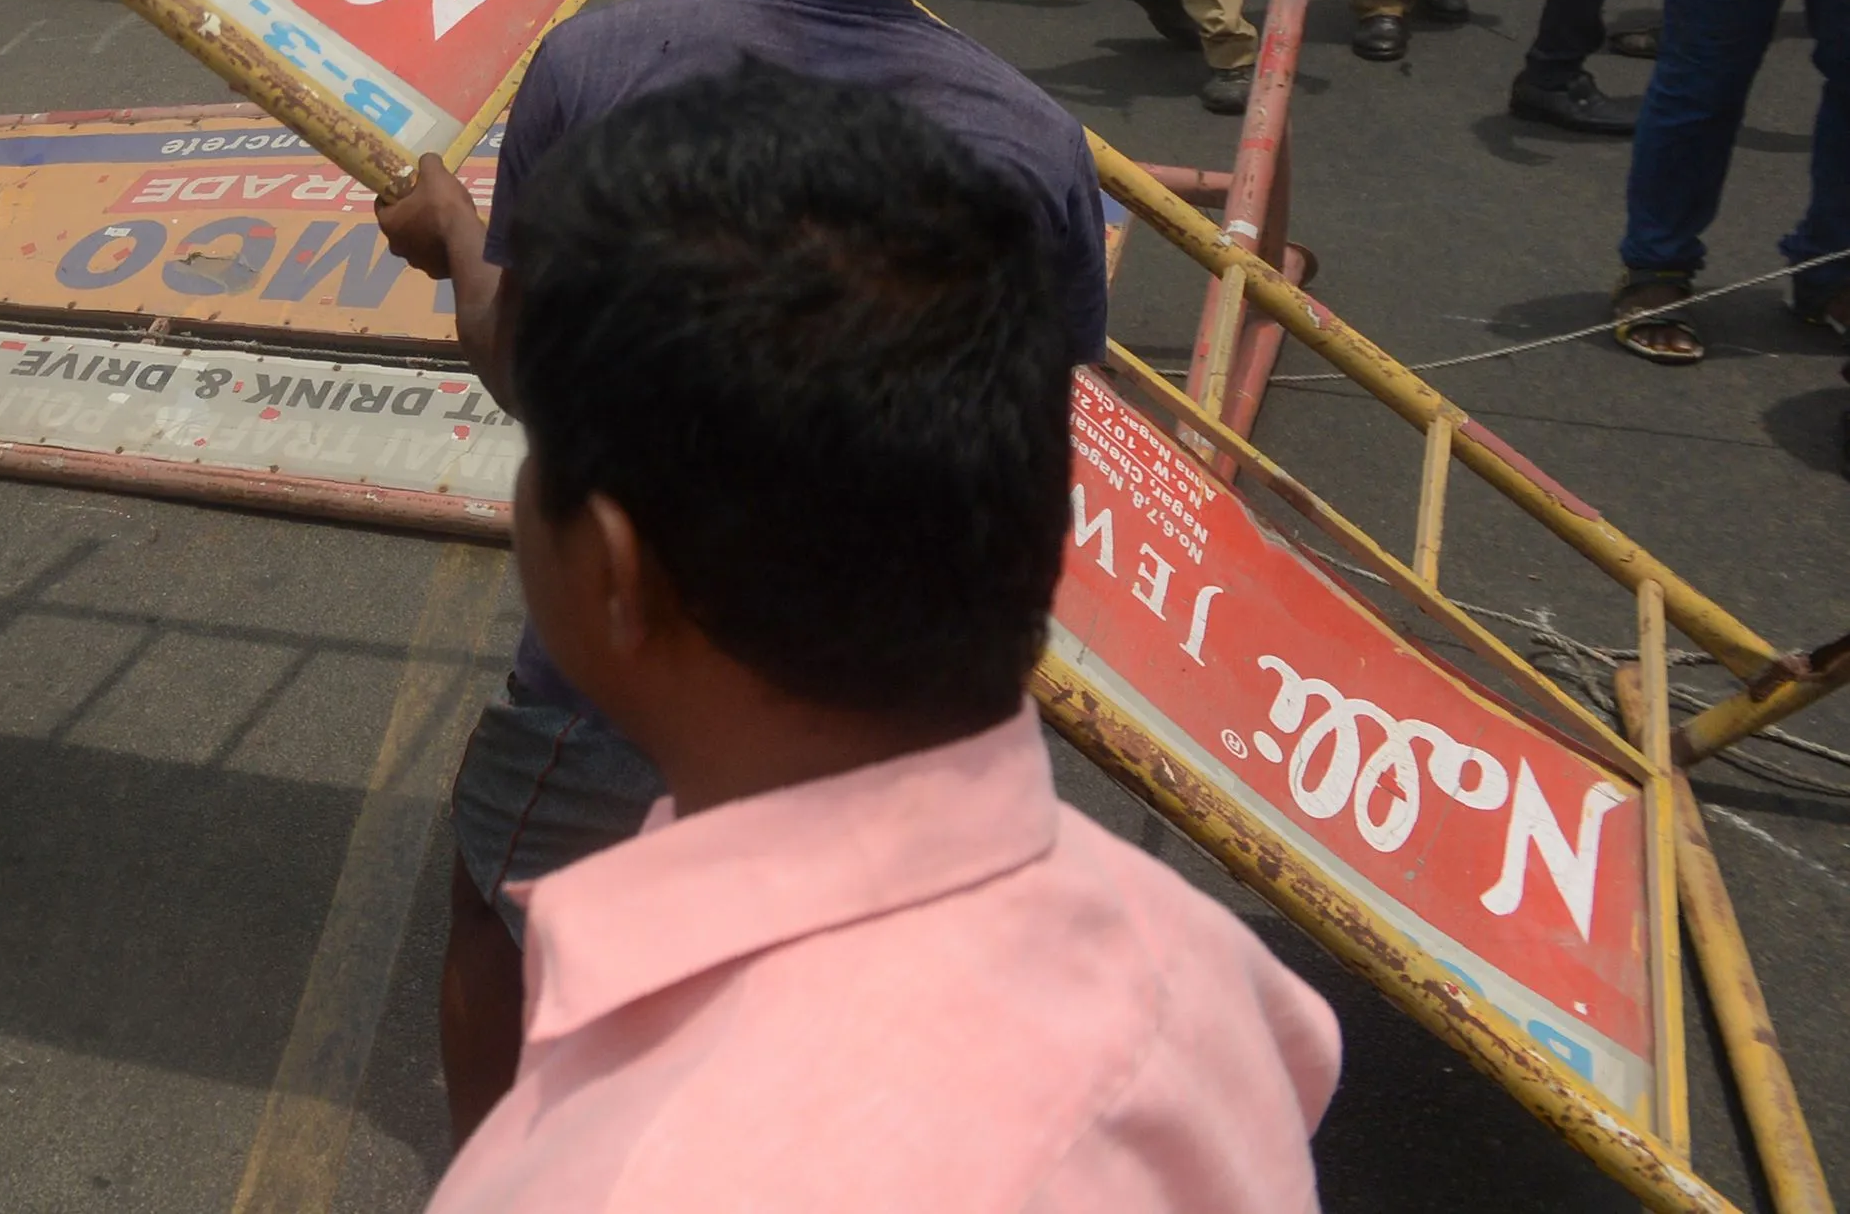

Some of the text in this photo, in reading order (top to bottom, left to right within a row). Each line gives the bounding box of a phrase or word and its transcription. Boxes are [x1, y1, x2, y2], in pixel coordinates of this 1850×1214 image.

[10, 351, 176, 392] DRIVE
[195, 369, 232, 399] &
[242, 374, 434, 416] DRINK
[1120, 409, 1171, 462] Nagar,
[1150, 479, 1208, 544] Nagar,
[1253, 655, 1629, 943] Nalli
